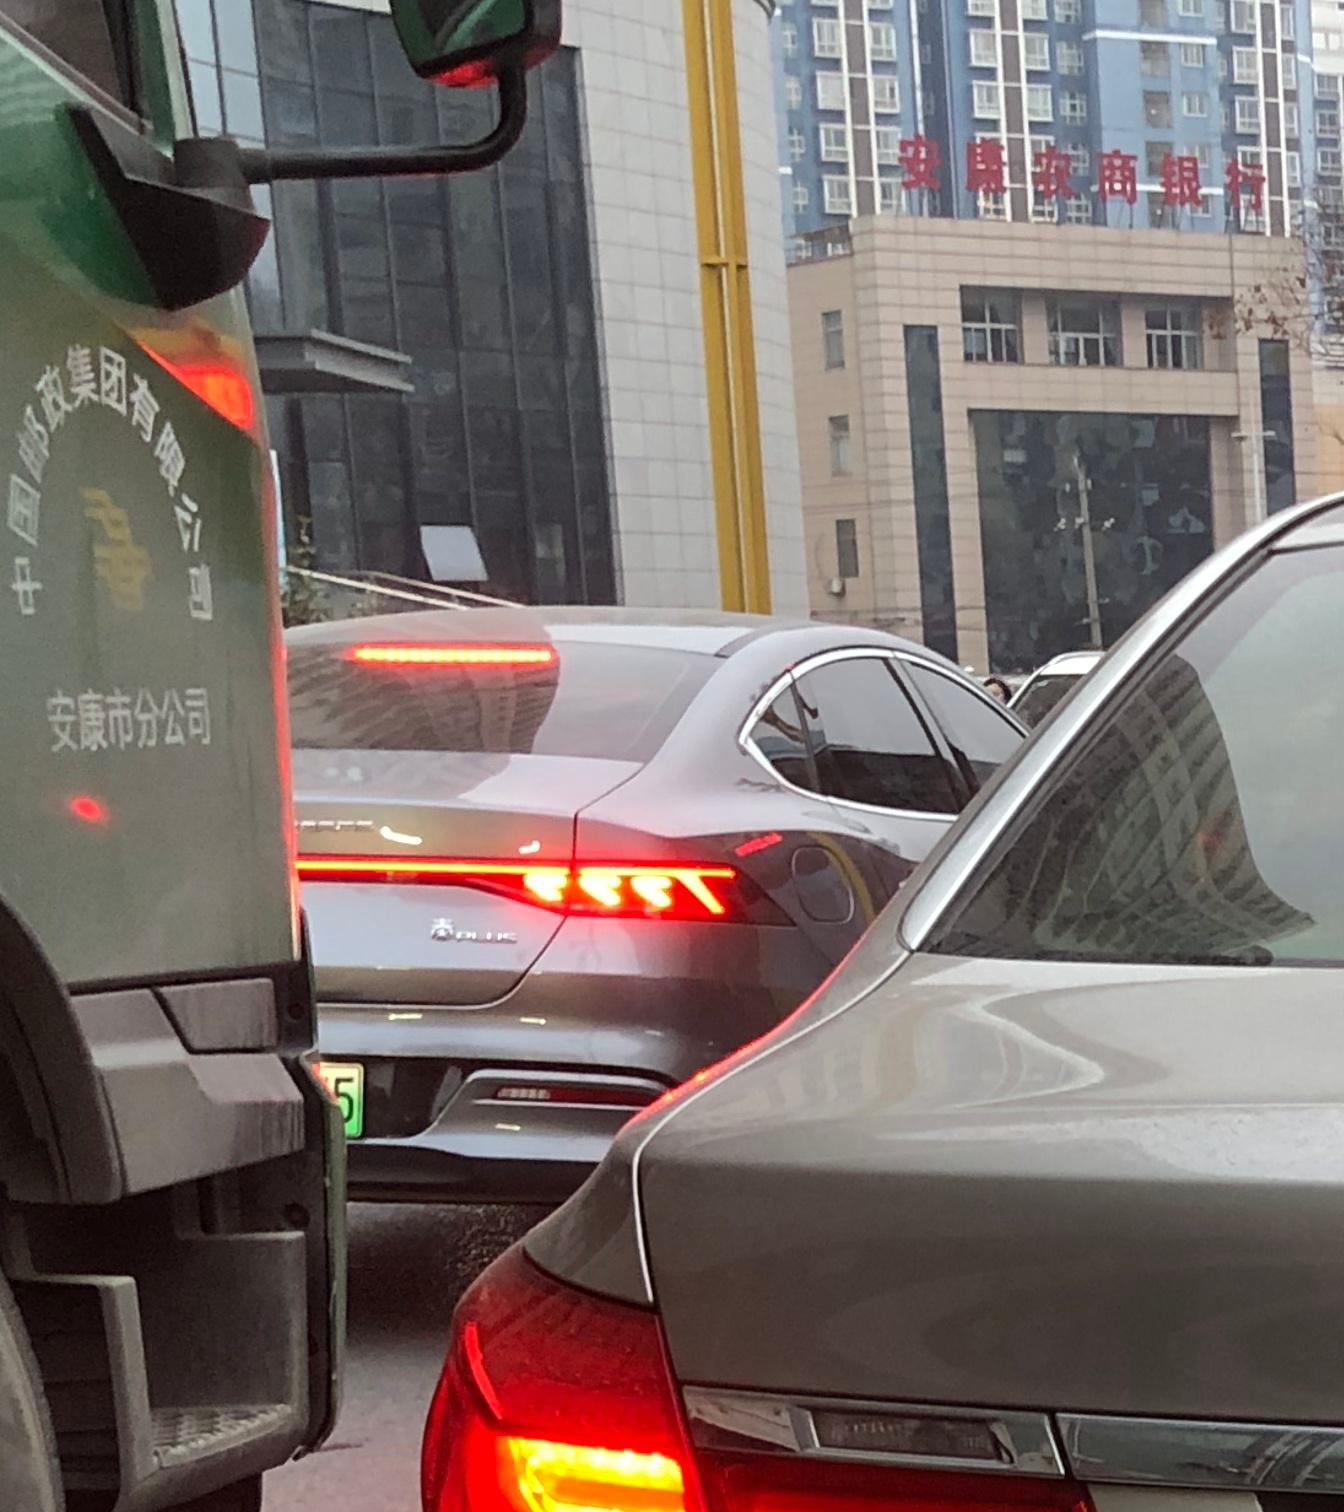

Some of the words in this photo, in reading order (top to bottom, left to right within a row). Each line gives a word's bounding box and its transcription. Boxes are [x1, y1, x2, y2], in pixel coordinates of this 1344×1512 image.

[899, 133, 1266, 211] 安康农商银行
[7, 343, 214, 621] 中国邮政集团有限公司
[46, 687, 212, 752] 安康市分公司
